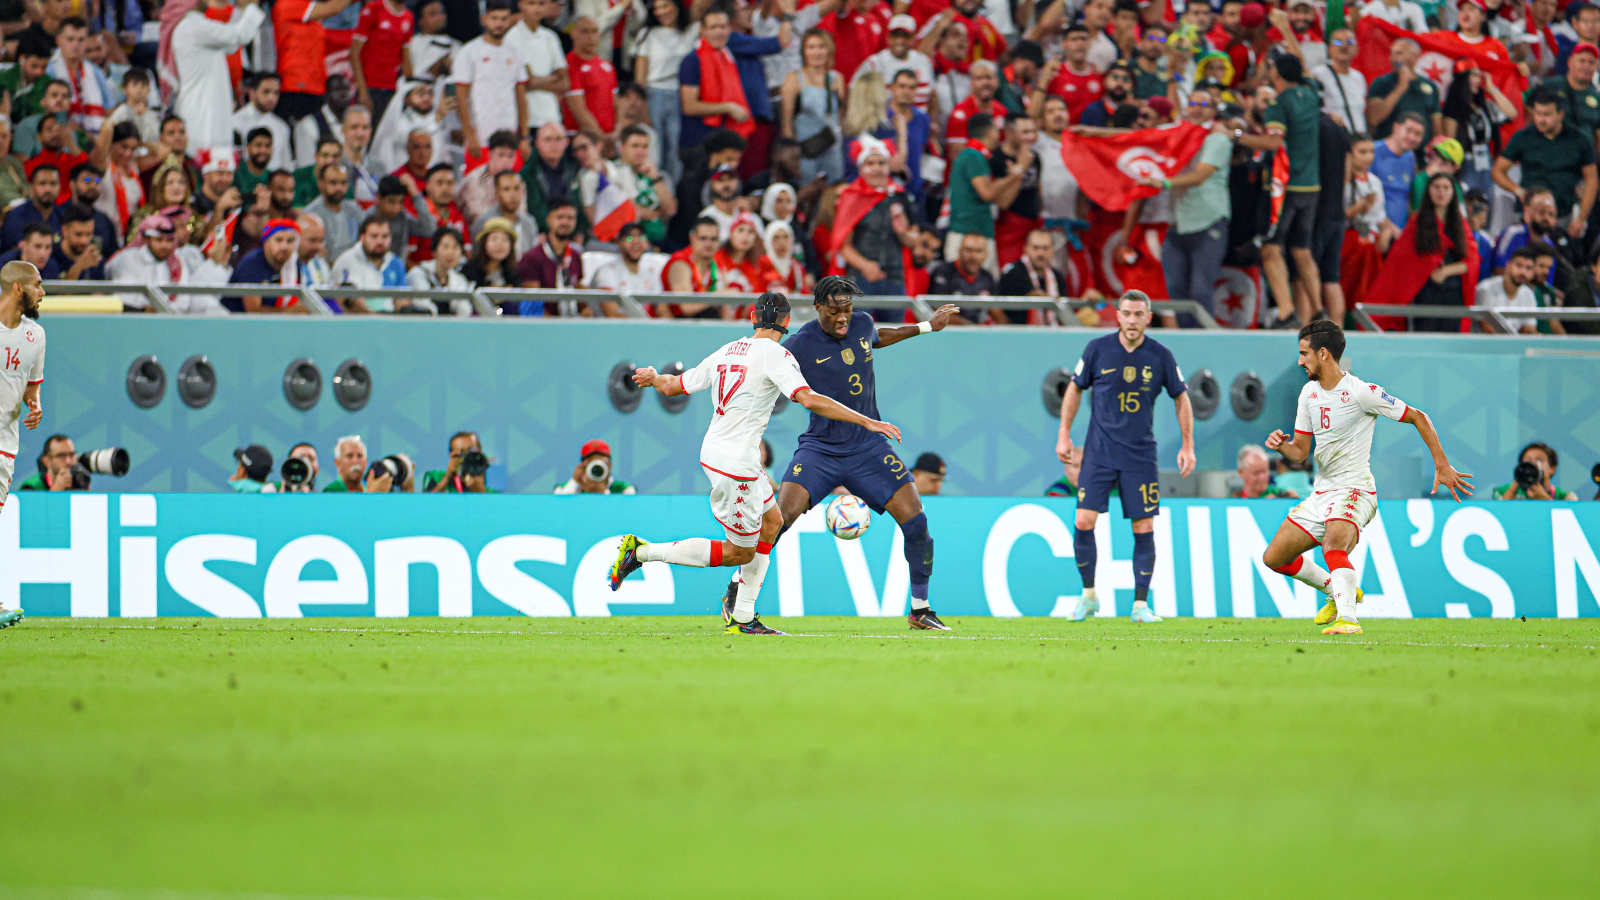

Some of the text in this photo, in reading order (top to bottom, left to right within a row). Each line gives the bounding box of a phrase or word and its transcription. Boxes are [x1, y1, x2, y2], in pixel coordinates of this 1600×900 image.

[4, 346, 21, 371] 14
[716, 364, 748, 415] 17
[848, 373, 863, 395] 3
[1117, 391, 1140, 413] 15
[1319, 406, 1332, 430] 15
[883, 454, 904, 473] 3
[1139, 482, 1160, 504] 15
[0, 493, 675, 618] Hisense
[774, 502, 912, 618] TV
[982, 498, 1516, 618] CHINA'S
